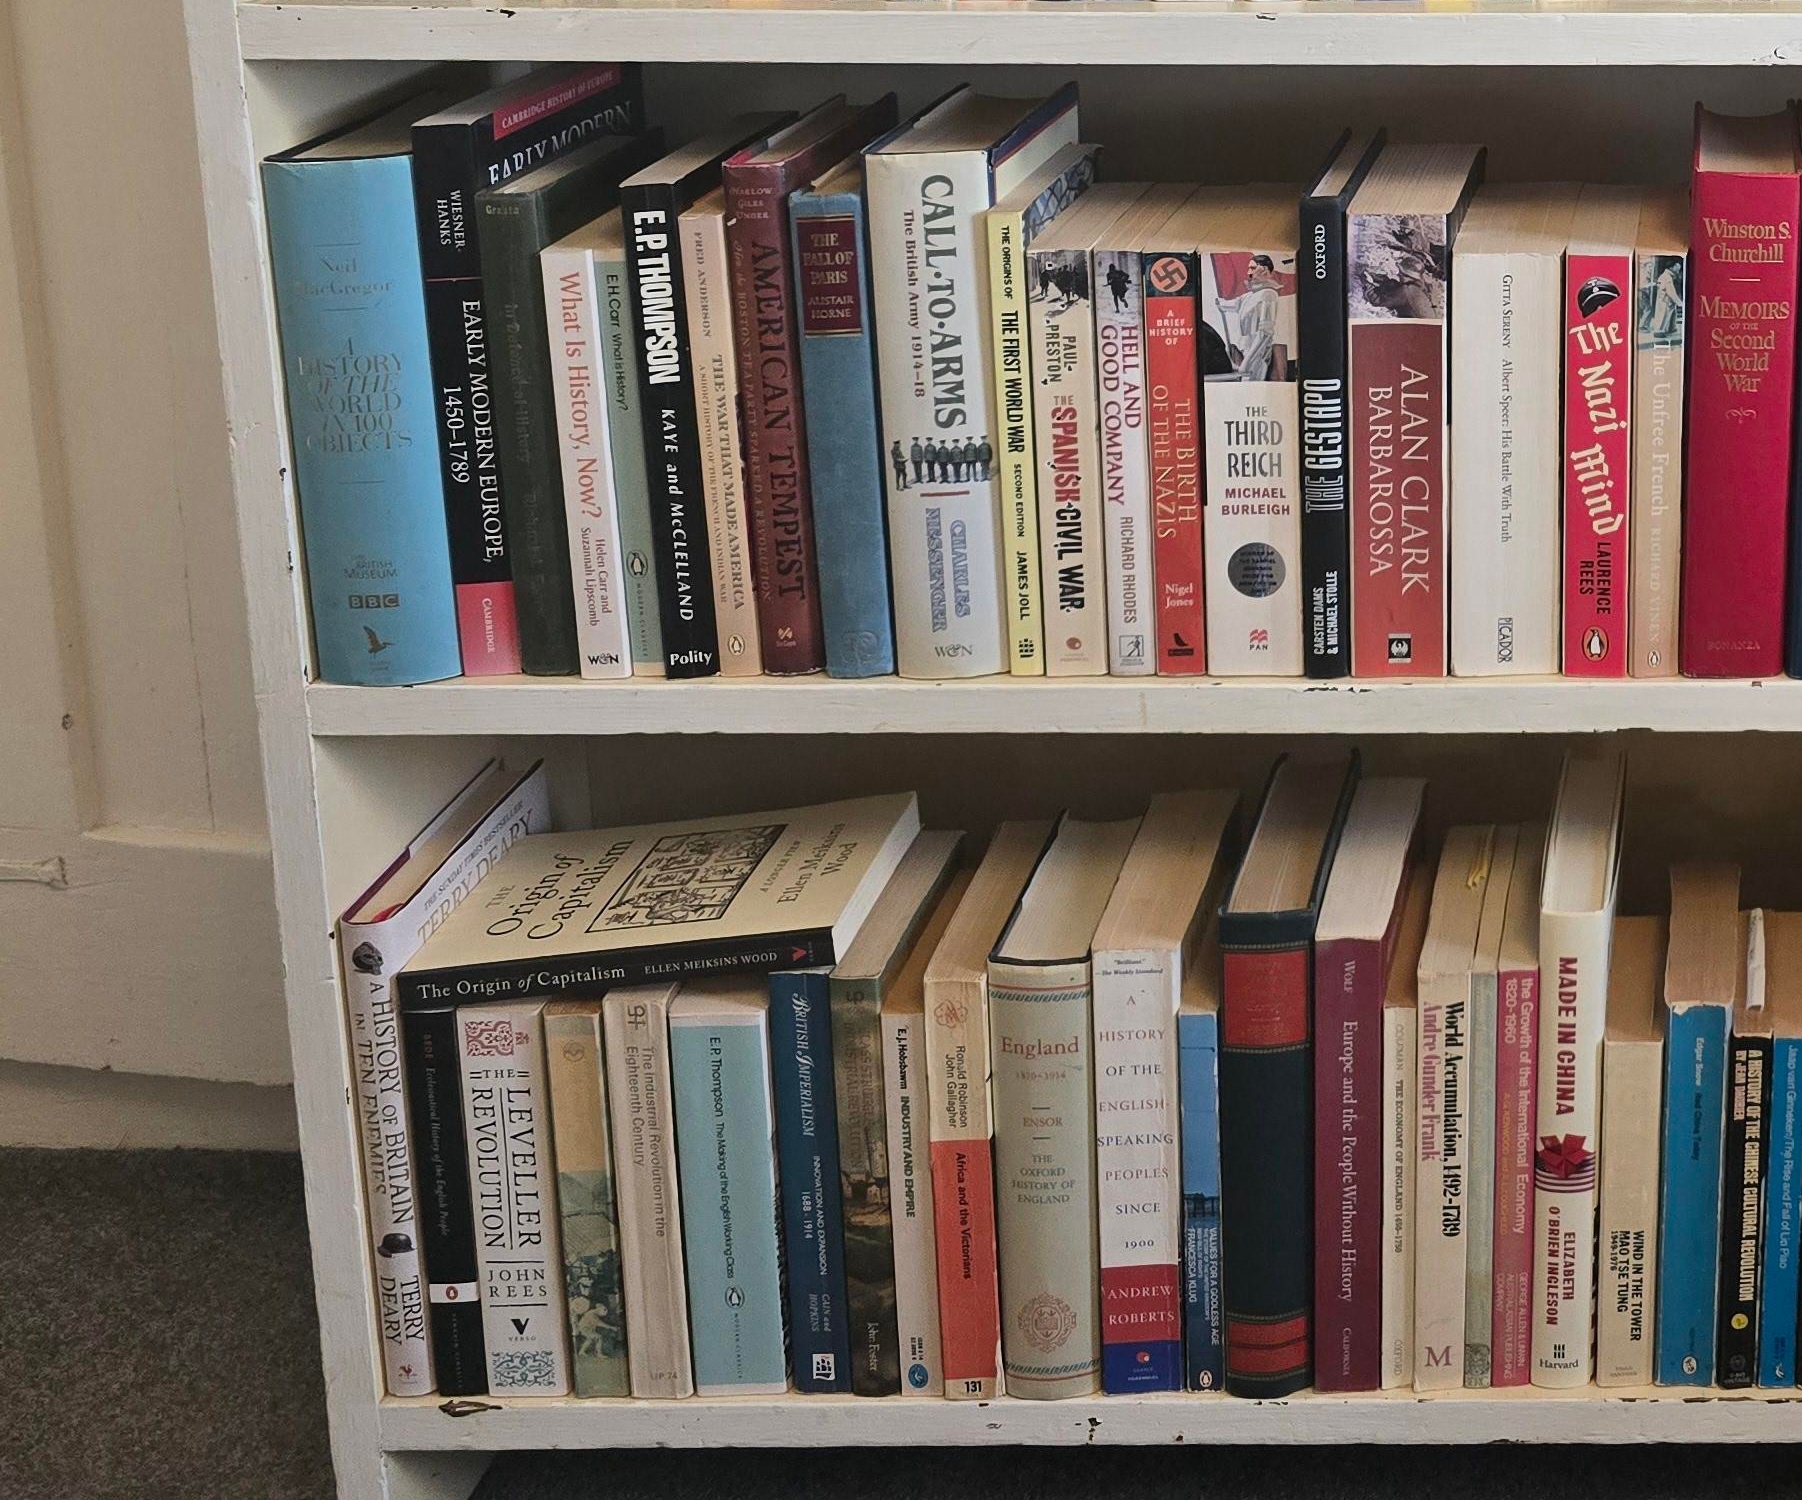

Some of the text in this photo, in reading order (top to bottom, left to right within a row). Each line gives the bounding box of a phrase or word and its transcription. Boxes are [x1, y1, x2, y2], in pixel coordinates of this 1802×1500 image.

[1703, 217, 1774, 240] Winston
[1710, 243, 1784, 264] Churchill
[640, 252, 681, 385] THOMPSON
[559, 272, 594, 451] What History,
[1224, 420, 1283, 446] THIRD
[1227, 450, 1282, 478] REICH
[1368, 386, 1395, 577] BARBAROSSA
[1401, 363, 1430, 596] ALAN CLARK
[1225, 487, 1286, 499] MICHAEL
[1221, 504, 1290, 516] BURLEIGH
[670, 651, 712, 666] Polity
[418, 965, 626, 998] The Origin of Capitalism
[1001, 1036, 1079, 1058] England
[1555, 956, 1579, 1116] MADE IN CHINA
[1097, 1132, 1174, 1146] SPEAKING
[471, 1088, 506, 1249] REVOLUTION
[506, 1087, 544, 1247] LEVELLER
[1125, 1238, 1155, 1248] 1900
[490, 1285, 547, 1298] REES
[1108, 1284, 1173, 1300] ANDREW
[1109, 1310, 1174, 1326] ROBERTS
[1539, 1358, 1579, 1369] Harvard
[964, 1380, 982, 1393] 131
